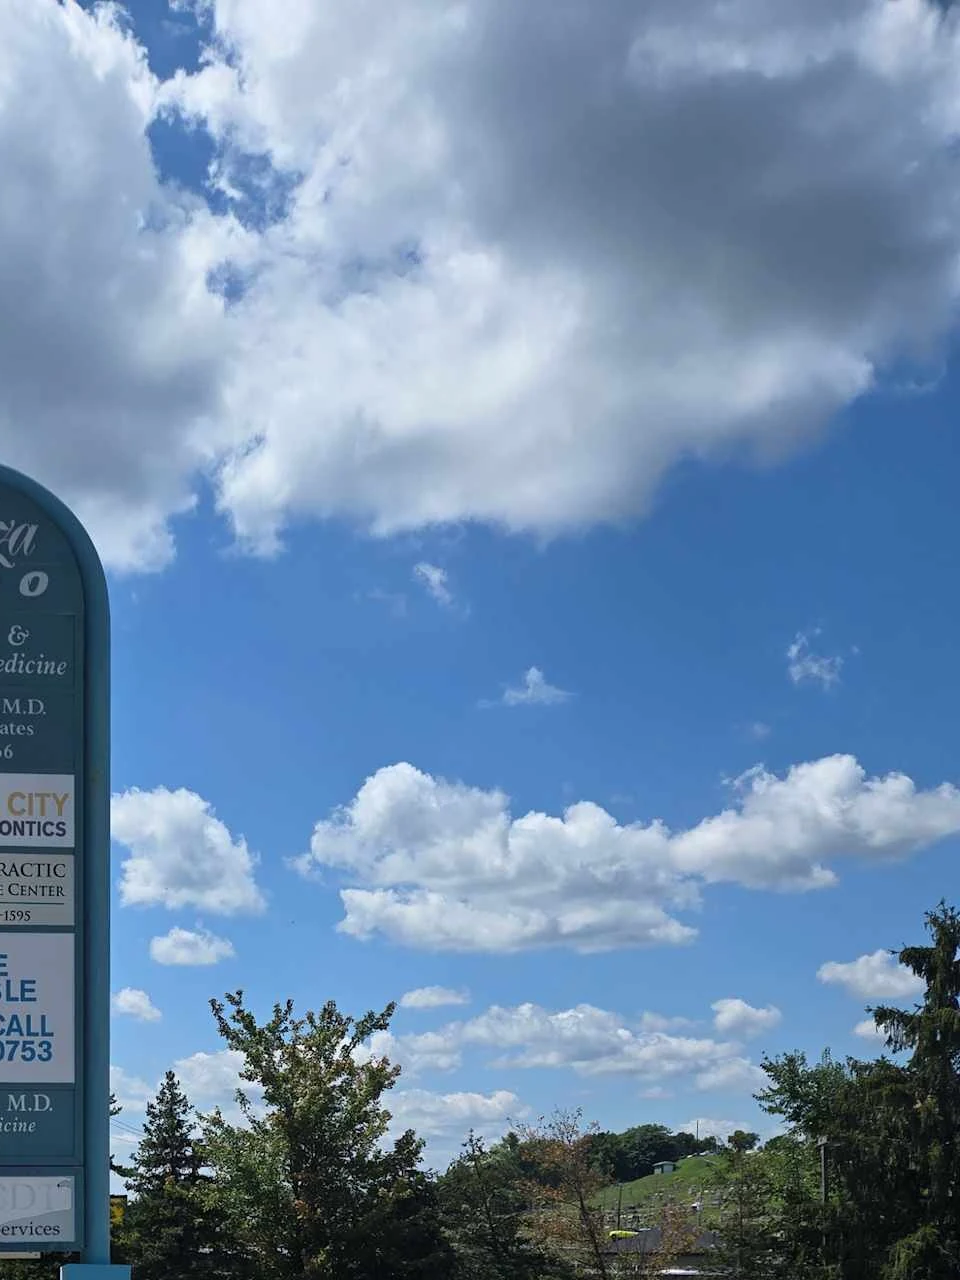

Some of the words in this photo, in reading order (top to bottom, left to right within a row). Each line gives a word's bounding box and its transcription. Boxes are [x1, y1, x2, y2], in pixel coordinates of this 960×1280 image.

[7, 625, 29, 646] &
[2, 698, 47, 716] M.D.
[7, 791, 69, 817] CITY
[7, 883, 65, 897] CENTER
[7, 1094, 53, 1112] M.D.
